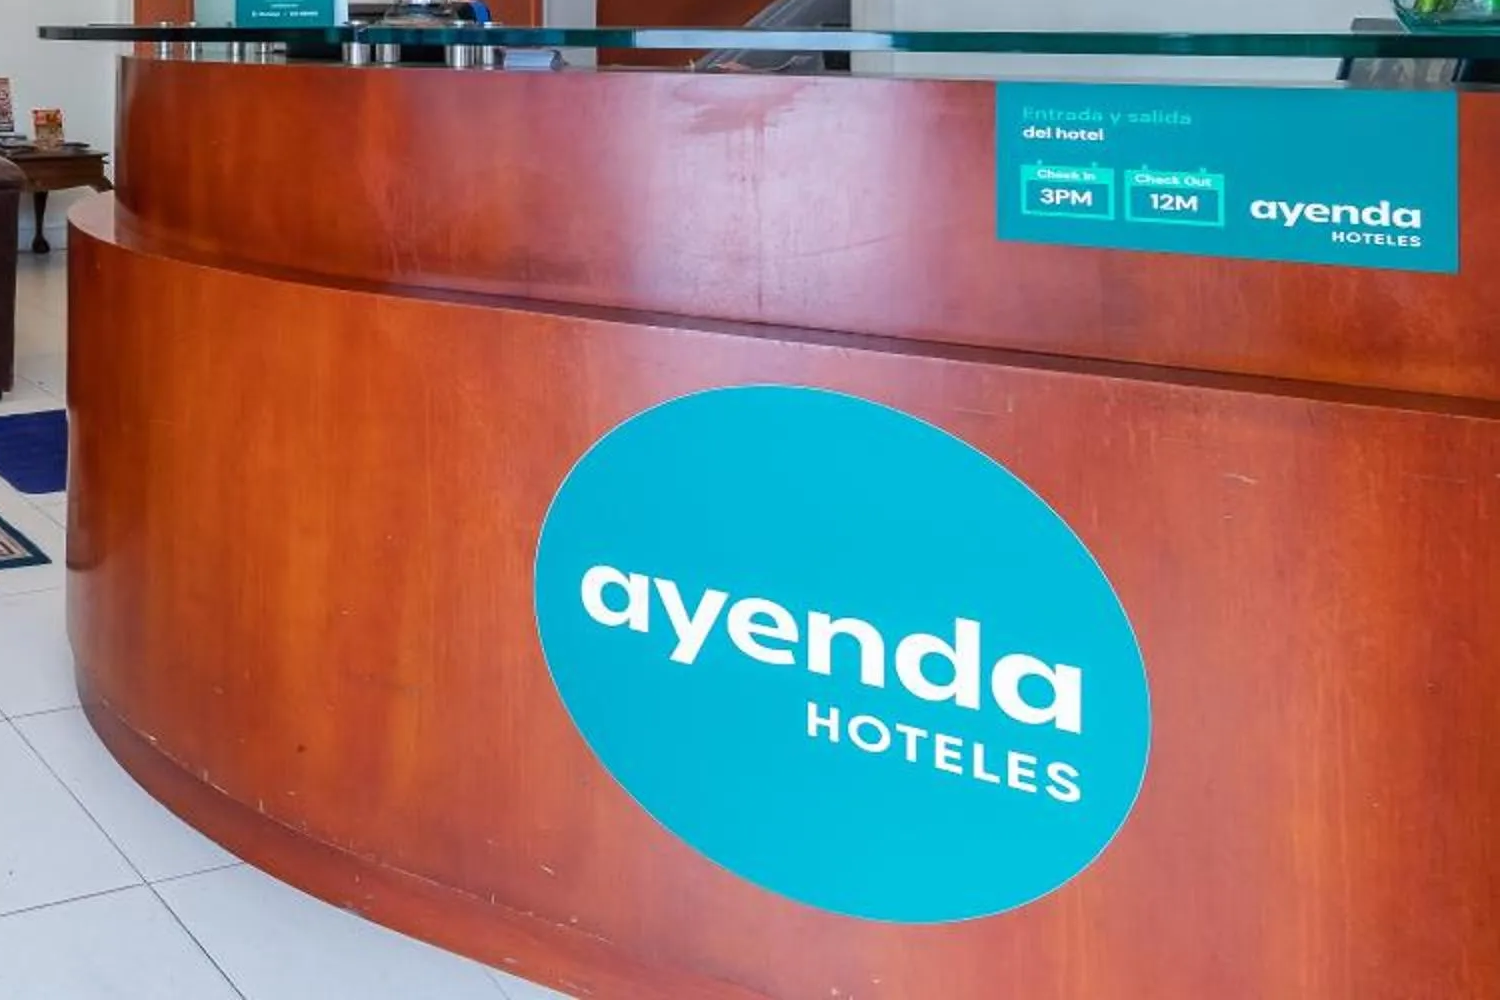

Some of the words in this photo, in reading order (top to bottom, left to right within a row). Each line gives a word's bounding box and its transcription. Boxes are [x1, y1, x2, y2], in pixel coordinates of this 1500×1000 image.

[1022, 106, 1103, 122] Entrada
[1110, 111, 1122, 125] y
[1128, 109, 1192, 126] salida
[1022, 125, 1052, 140] del
[1055, 127, 1105, 142] hotel
[1037, 168, 1080, 181] Check
[1083, 171, 1097, 182] In
[1134, 173, 1180, 186] Check
[1184, 175, 1213, 188] Out
[1039, 187, 1094, 207] 3PM
[1149, 192, 1199, 212] 12M
[1250, 199, 1422, 230] ayenda
[1331, 230, 1422, 248] HOTELES
[580, 564, 1083, 735] ayenda
[806, 700, 1082, 804] HOTELES
